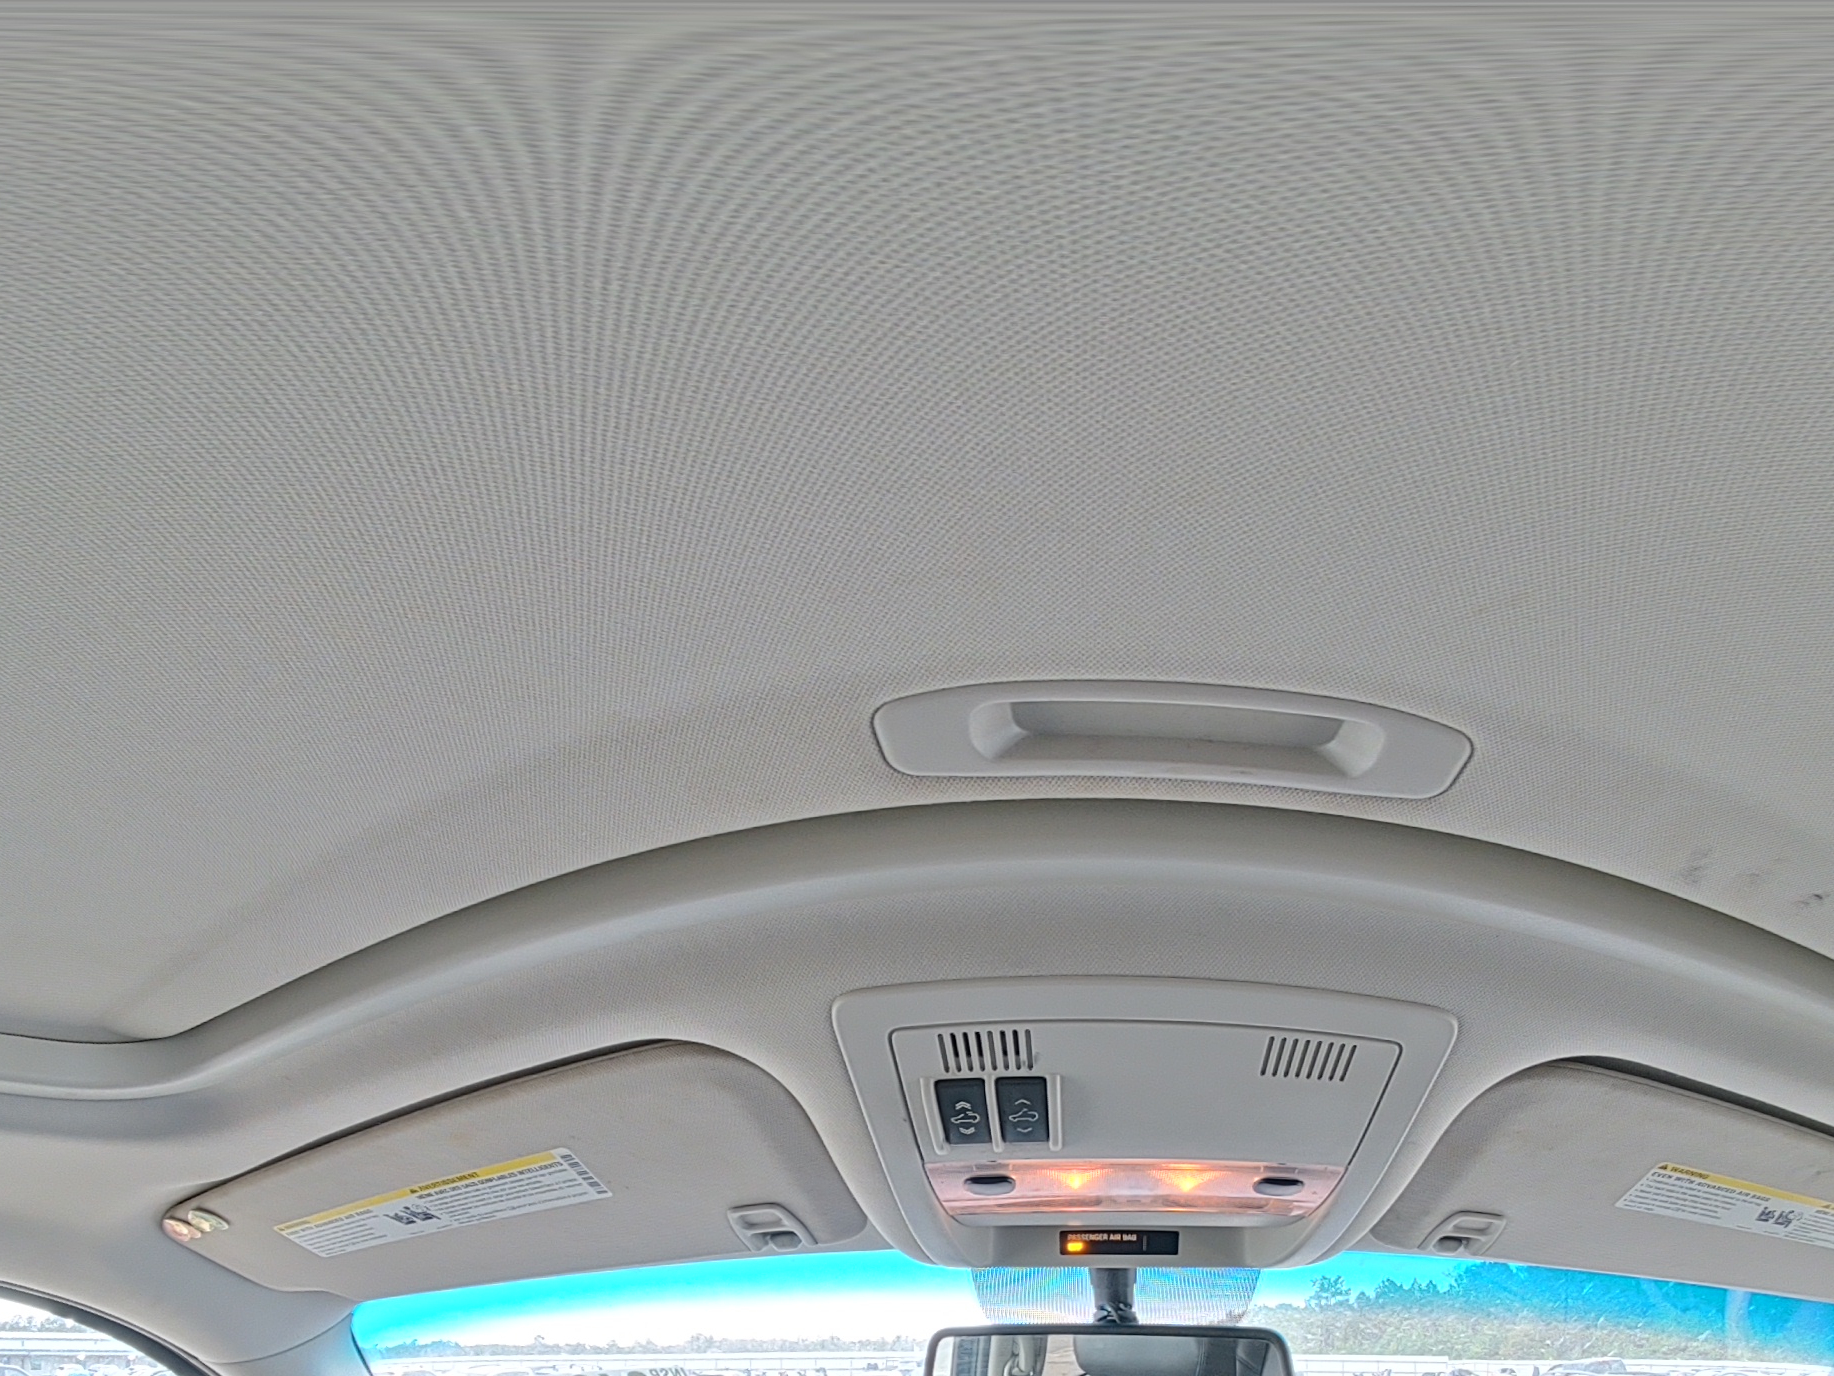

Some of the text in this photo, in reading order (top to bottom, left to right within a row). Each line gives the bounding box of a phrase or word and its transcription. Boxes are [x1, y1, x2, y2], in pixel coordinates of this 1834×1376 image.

[1670, 1166, 1710, 1180] WARNING
[1067, 1233, 1109, 1241] PASSENGER
[1109, 1233, 1122, 1241] AIR
